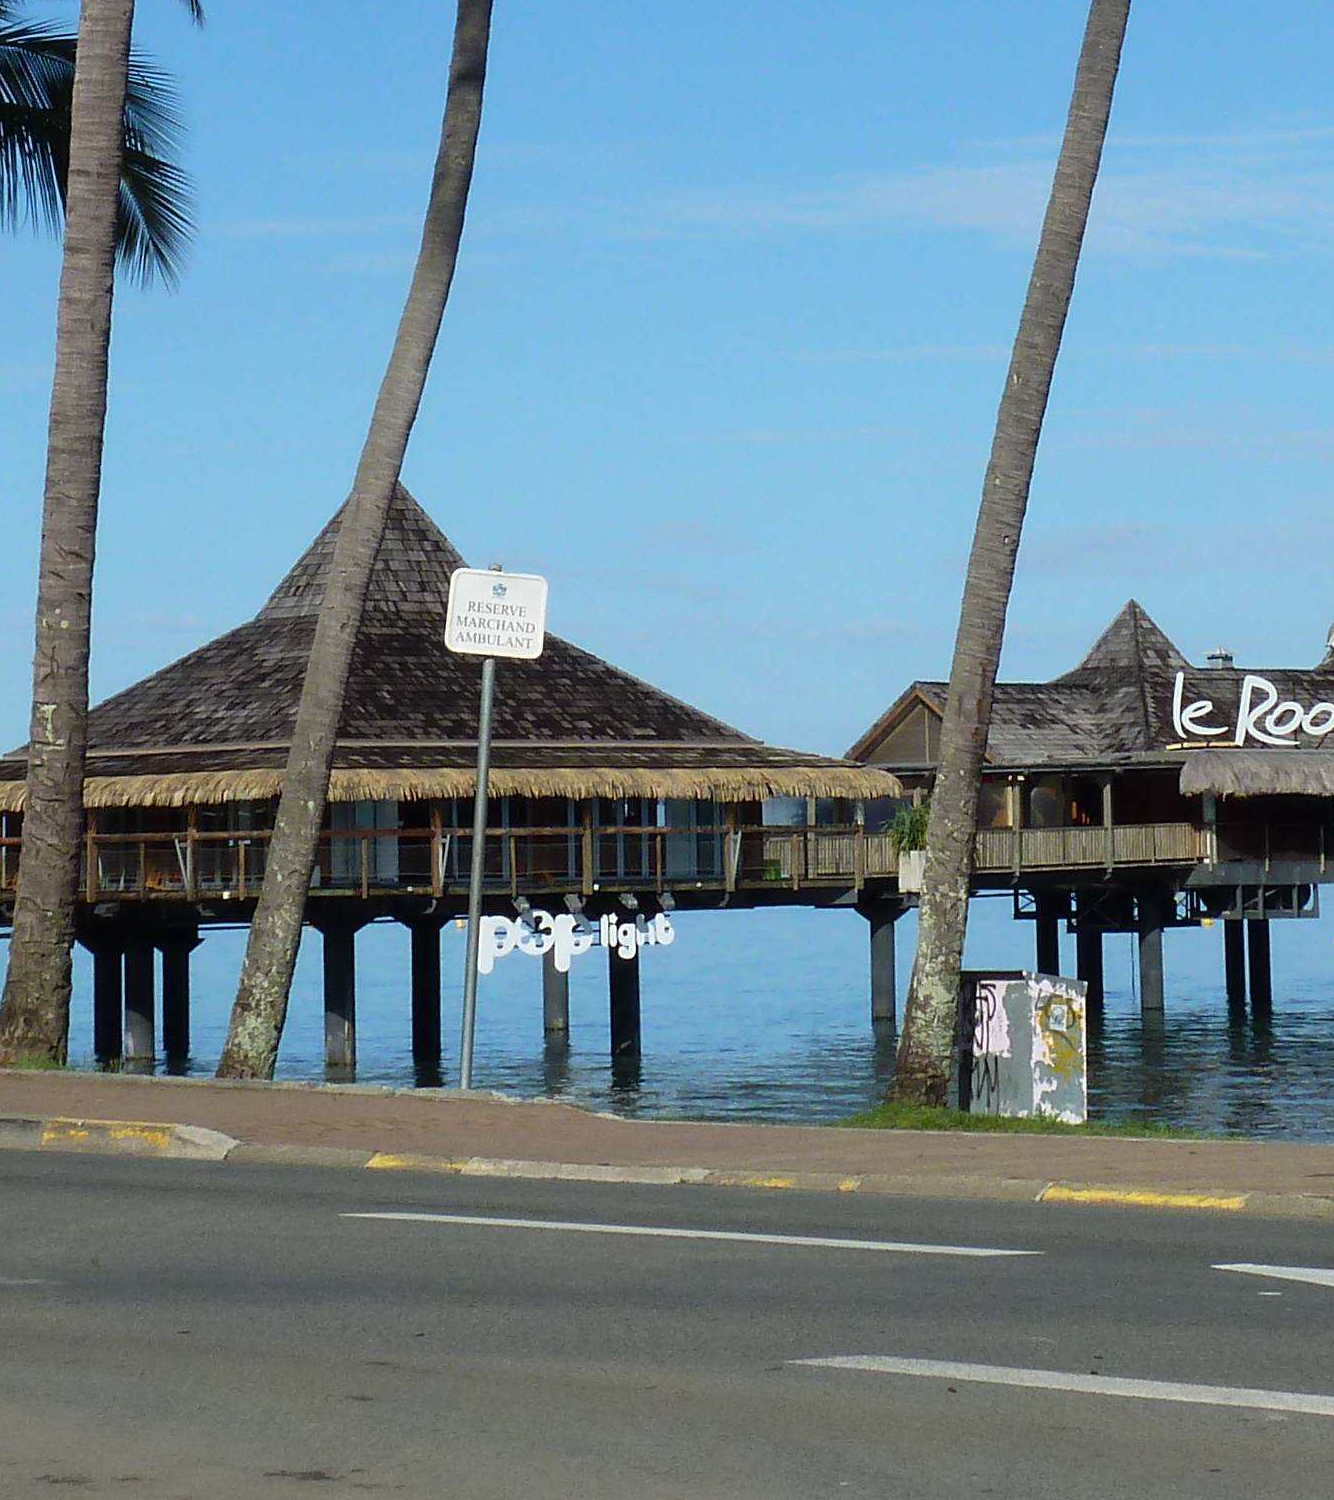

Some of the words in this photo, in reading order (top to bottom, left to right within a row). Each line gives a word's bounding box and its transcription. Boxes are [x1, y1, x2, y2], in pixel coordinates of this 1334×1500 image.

[468, 601, 527, 617] RESERVE
[456, 615, 535, 634] MARCHAND
[455, 631, 533, 649] AMBULANT
[1173, 671, 1229, 739] le
[600, 912, 675, 960] light
